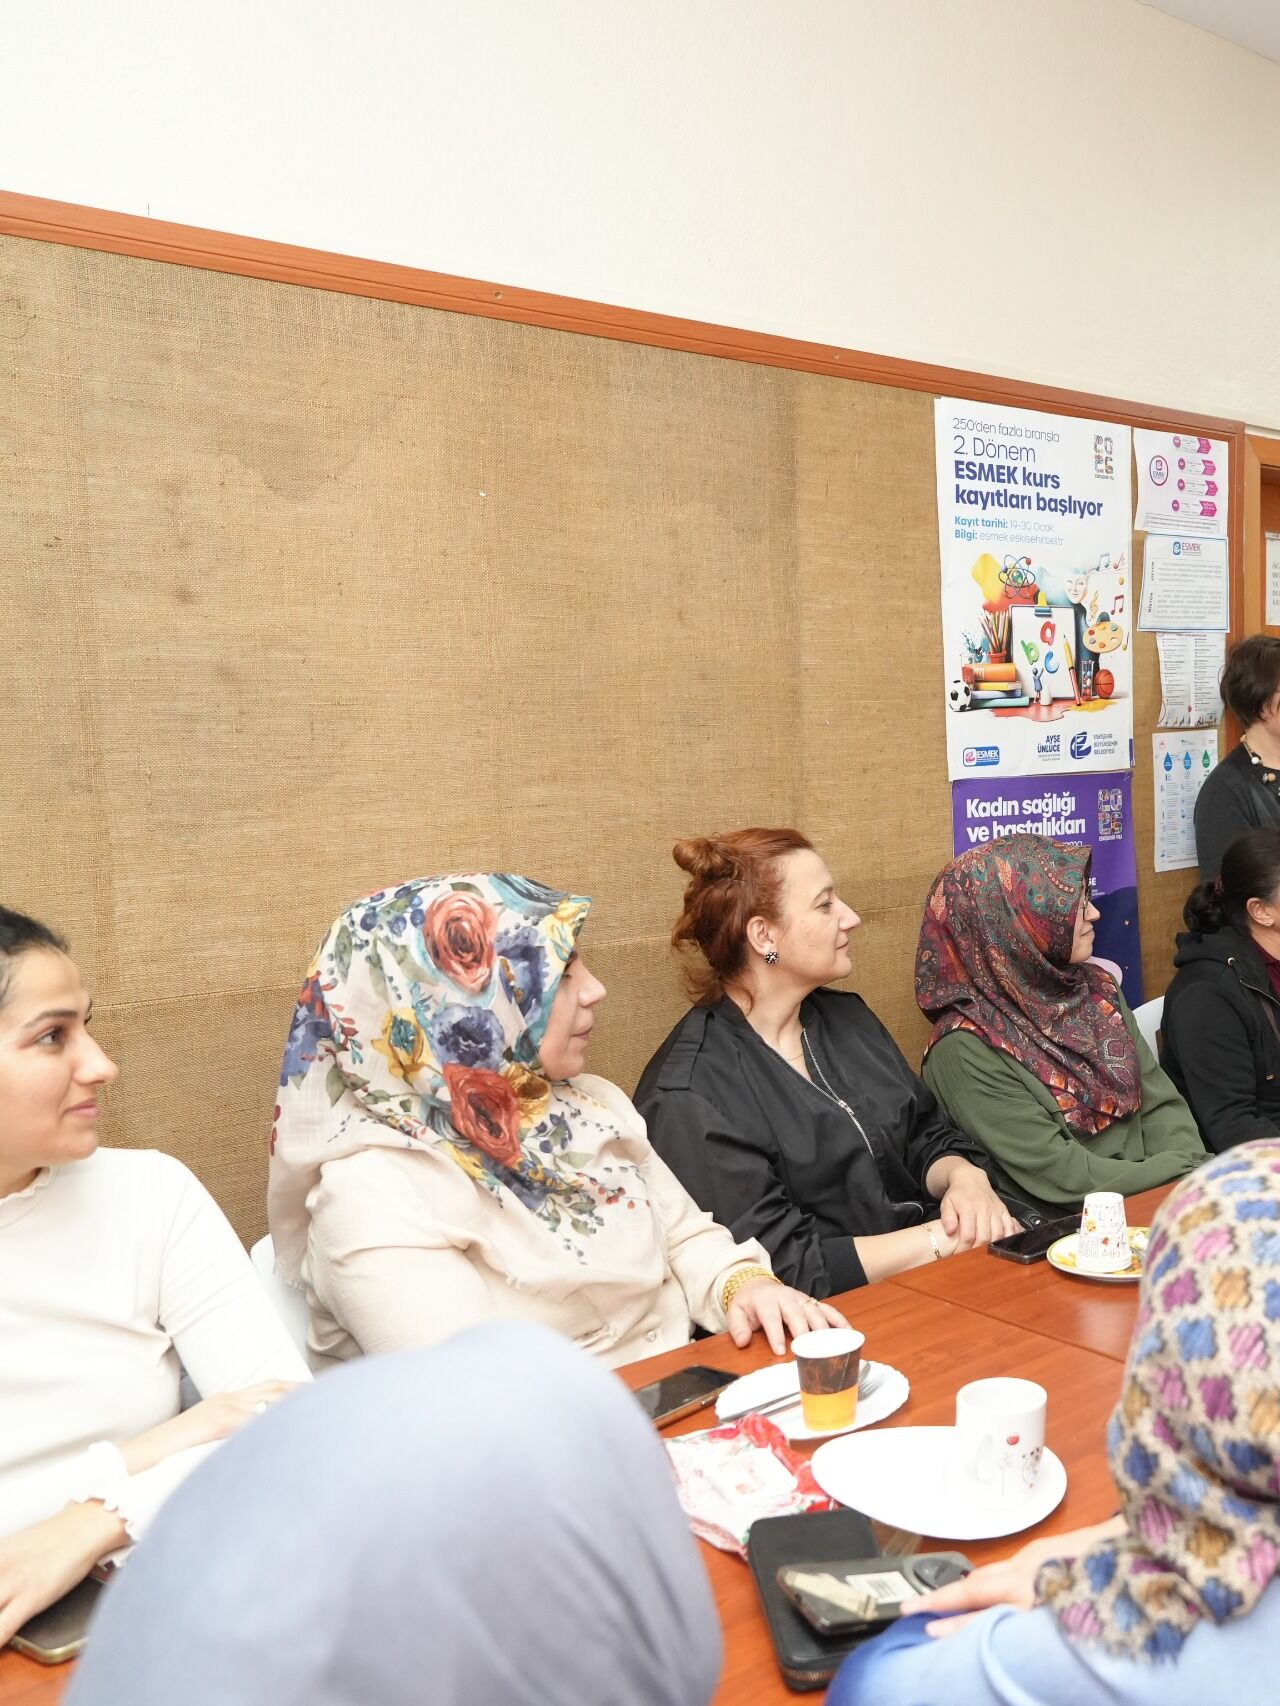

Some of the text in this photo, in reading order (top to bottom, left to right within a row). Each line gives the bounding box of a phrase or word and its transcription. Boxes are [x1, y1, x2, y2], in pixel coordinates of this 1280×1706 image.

[953, 417, 1060, 443] 250'den fazla branşla
[953, 435, 1036, 463] 2. Dönem
[954, 460, 1060, 490] ESMEK kurs
[955, 484, 1104, 519] kayıtları başlıyor
[954, 516, 979, 528] Kayıt
[982, 518, 1008, 528] tarihi:
[1034, 522, 1054, 532] Ocak
[954, 529, 978, 541] Bilgi:
[1181, 542, 1201, 551] ESMEK
[1046, 735, 1060, 744] AYŞE
[977, 750, 998, 758] ESMEK
[966, 792, 1075, 818] Kadın sağlığı
[966, 817, 1086, 842] ve hastalıkları
